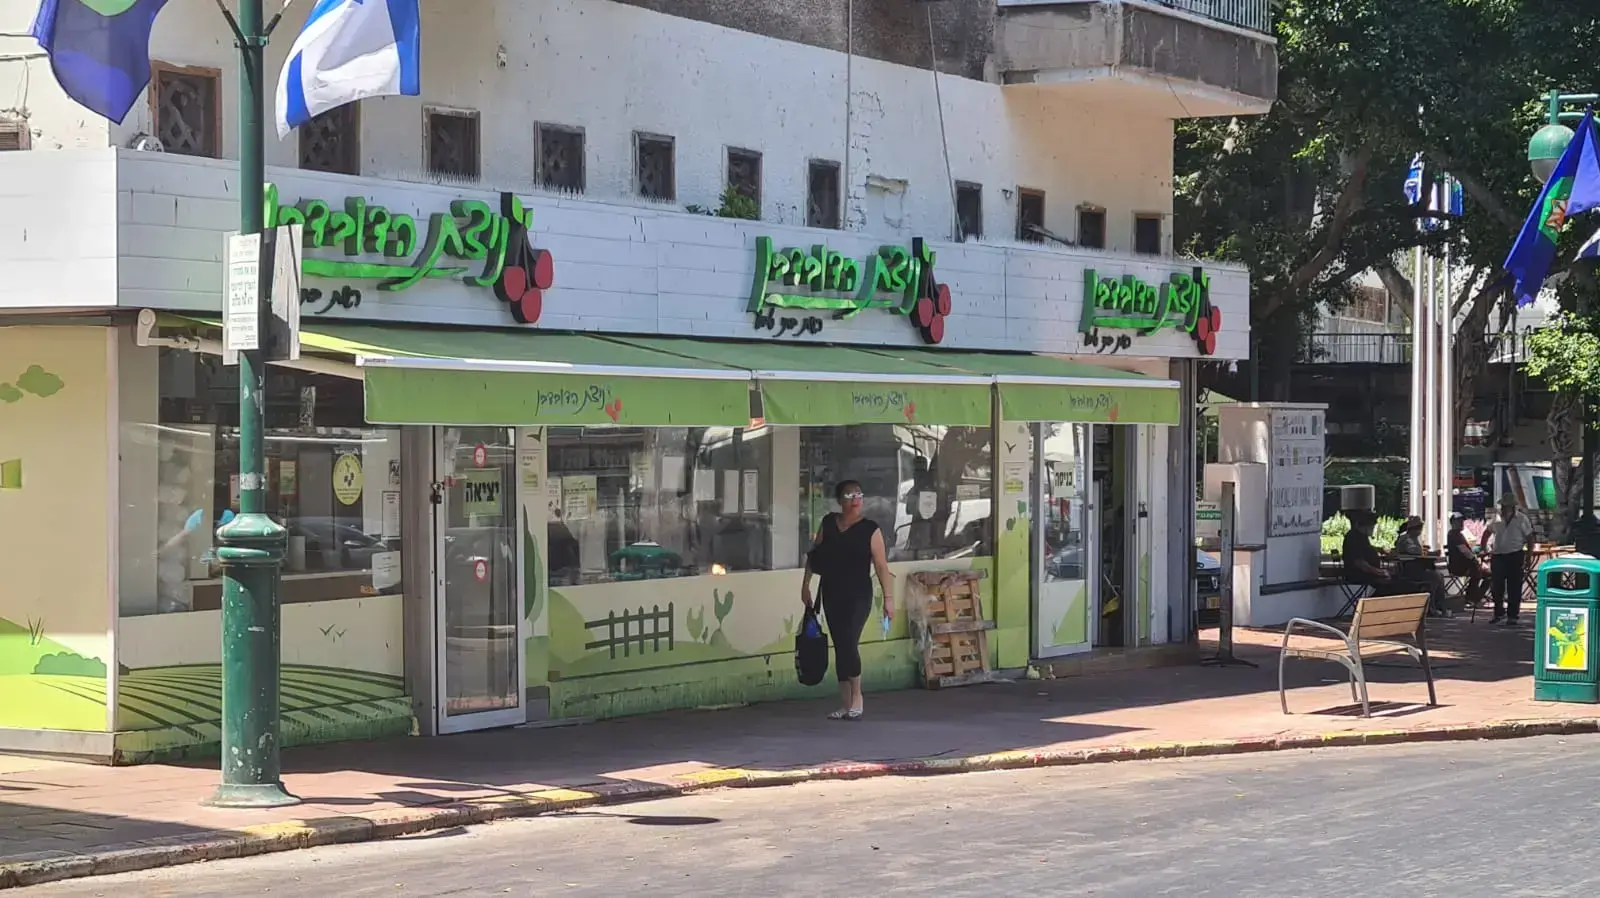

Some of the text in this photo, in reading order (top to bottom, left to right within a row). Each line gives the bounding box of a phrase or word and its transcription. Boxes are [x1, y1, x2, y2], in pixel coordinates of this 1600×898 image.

[376, 198, 510, 292] ניצת
[747, 236, 921, 320] ניצת הדובדבן
[1079, 268, 1200, 336] ניצת הדובדבן
[465, 481, 500, 503] יציאה
[1055, 471, 1073, 487] כניסה
